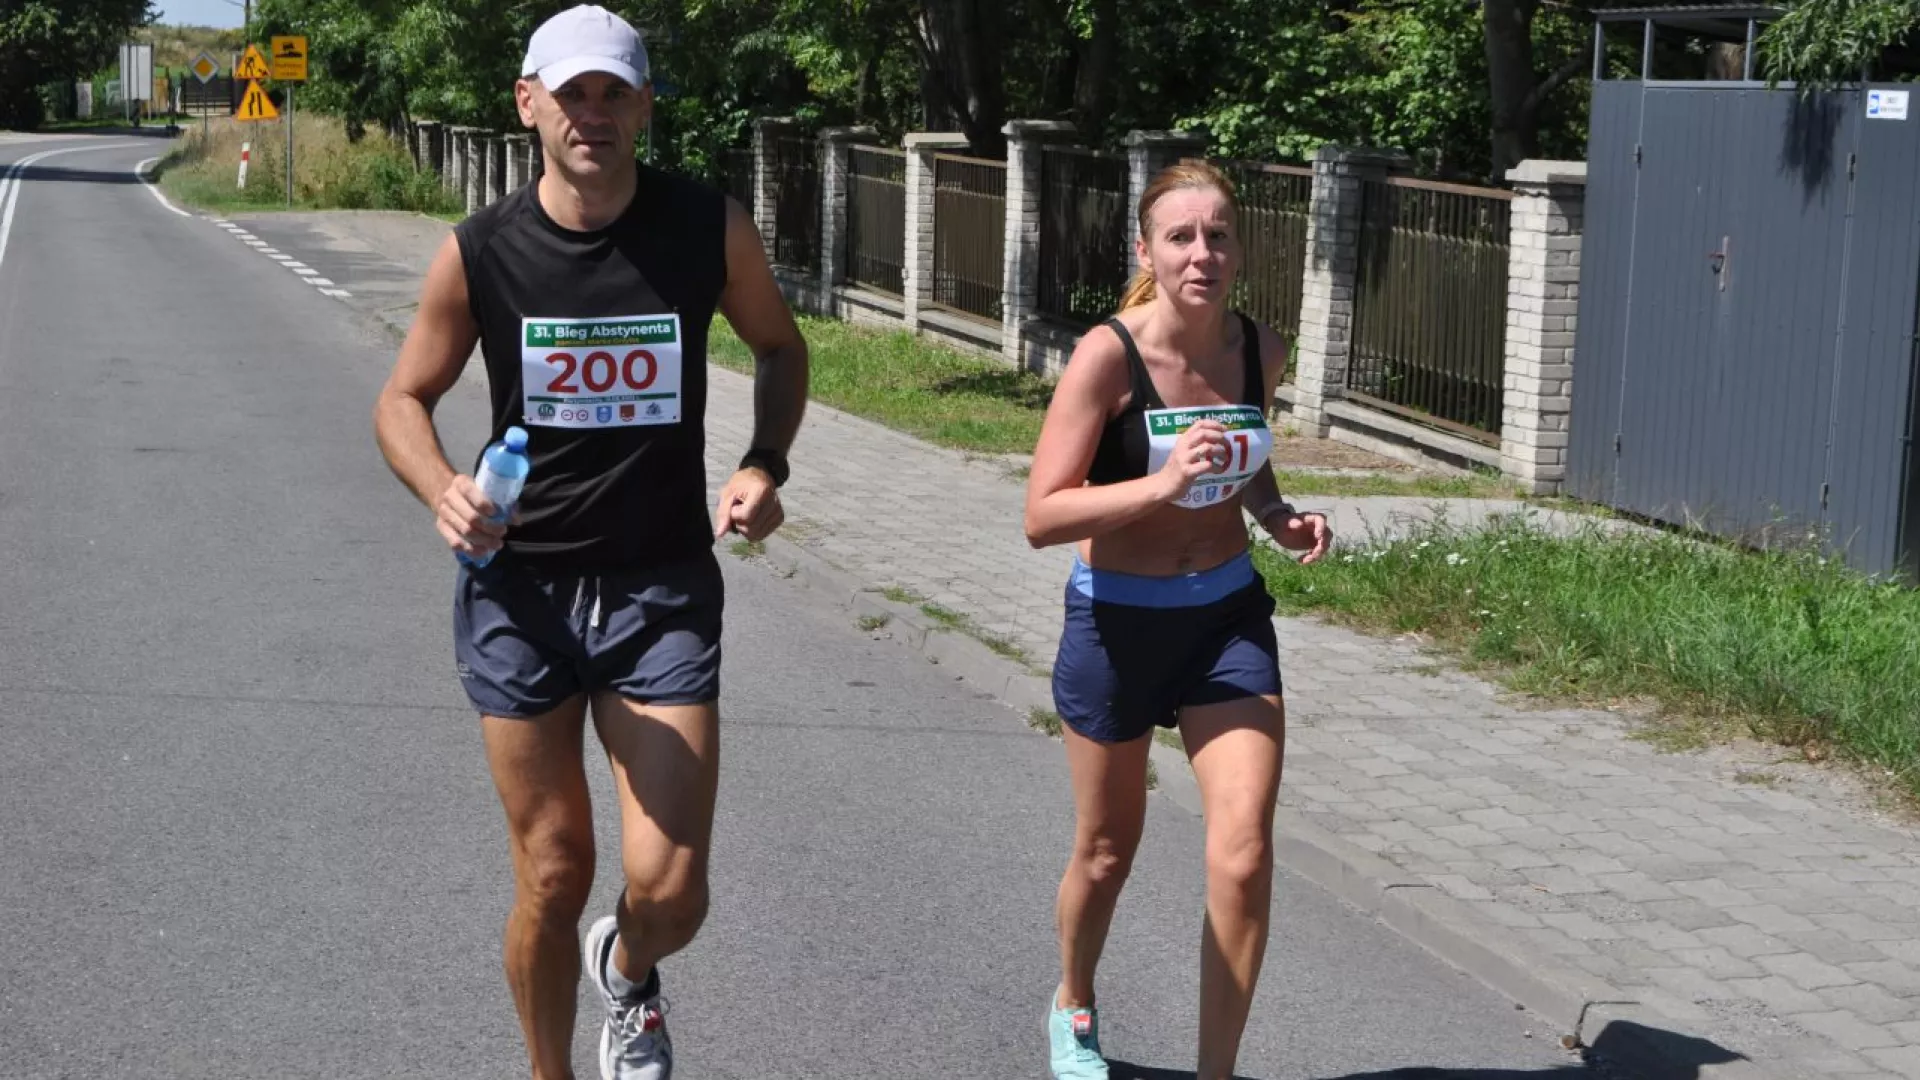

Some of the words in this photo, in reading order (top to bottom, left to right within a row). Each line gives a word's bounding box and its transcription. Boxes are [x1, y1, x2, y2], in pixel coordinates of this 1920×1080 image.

[533, 326, 551, 338] 31.
[555, 325, 588, 340] Bieg
[591, 322, 671, 338] Abstynenta
[545, 350, 657, 393] 200
[1156, 417, 1172, 427] 31.
